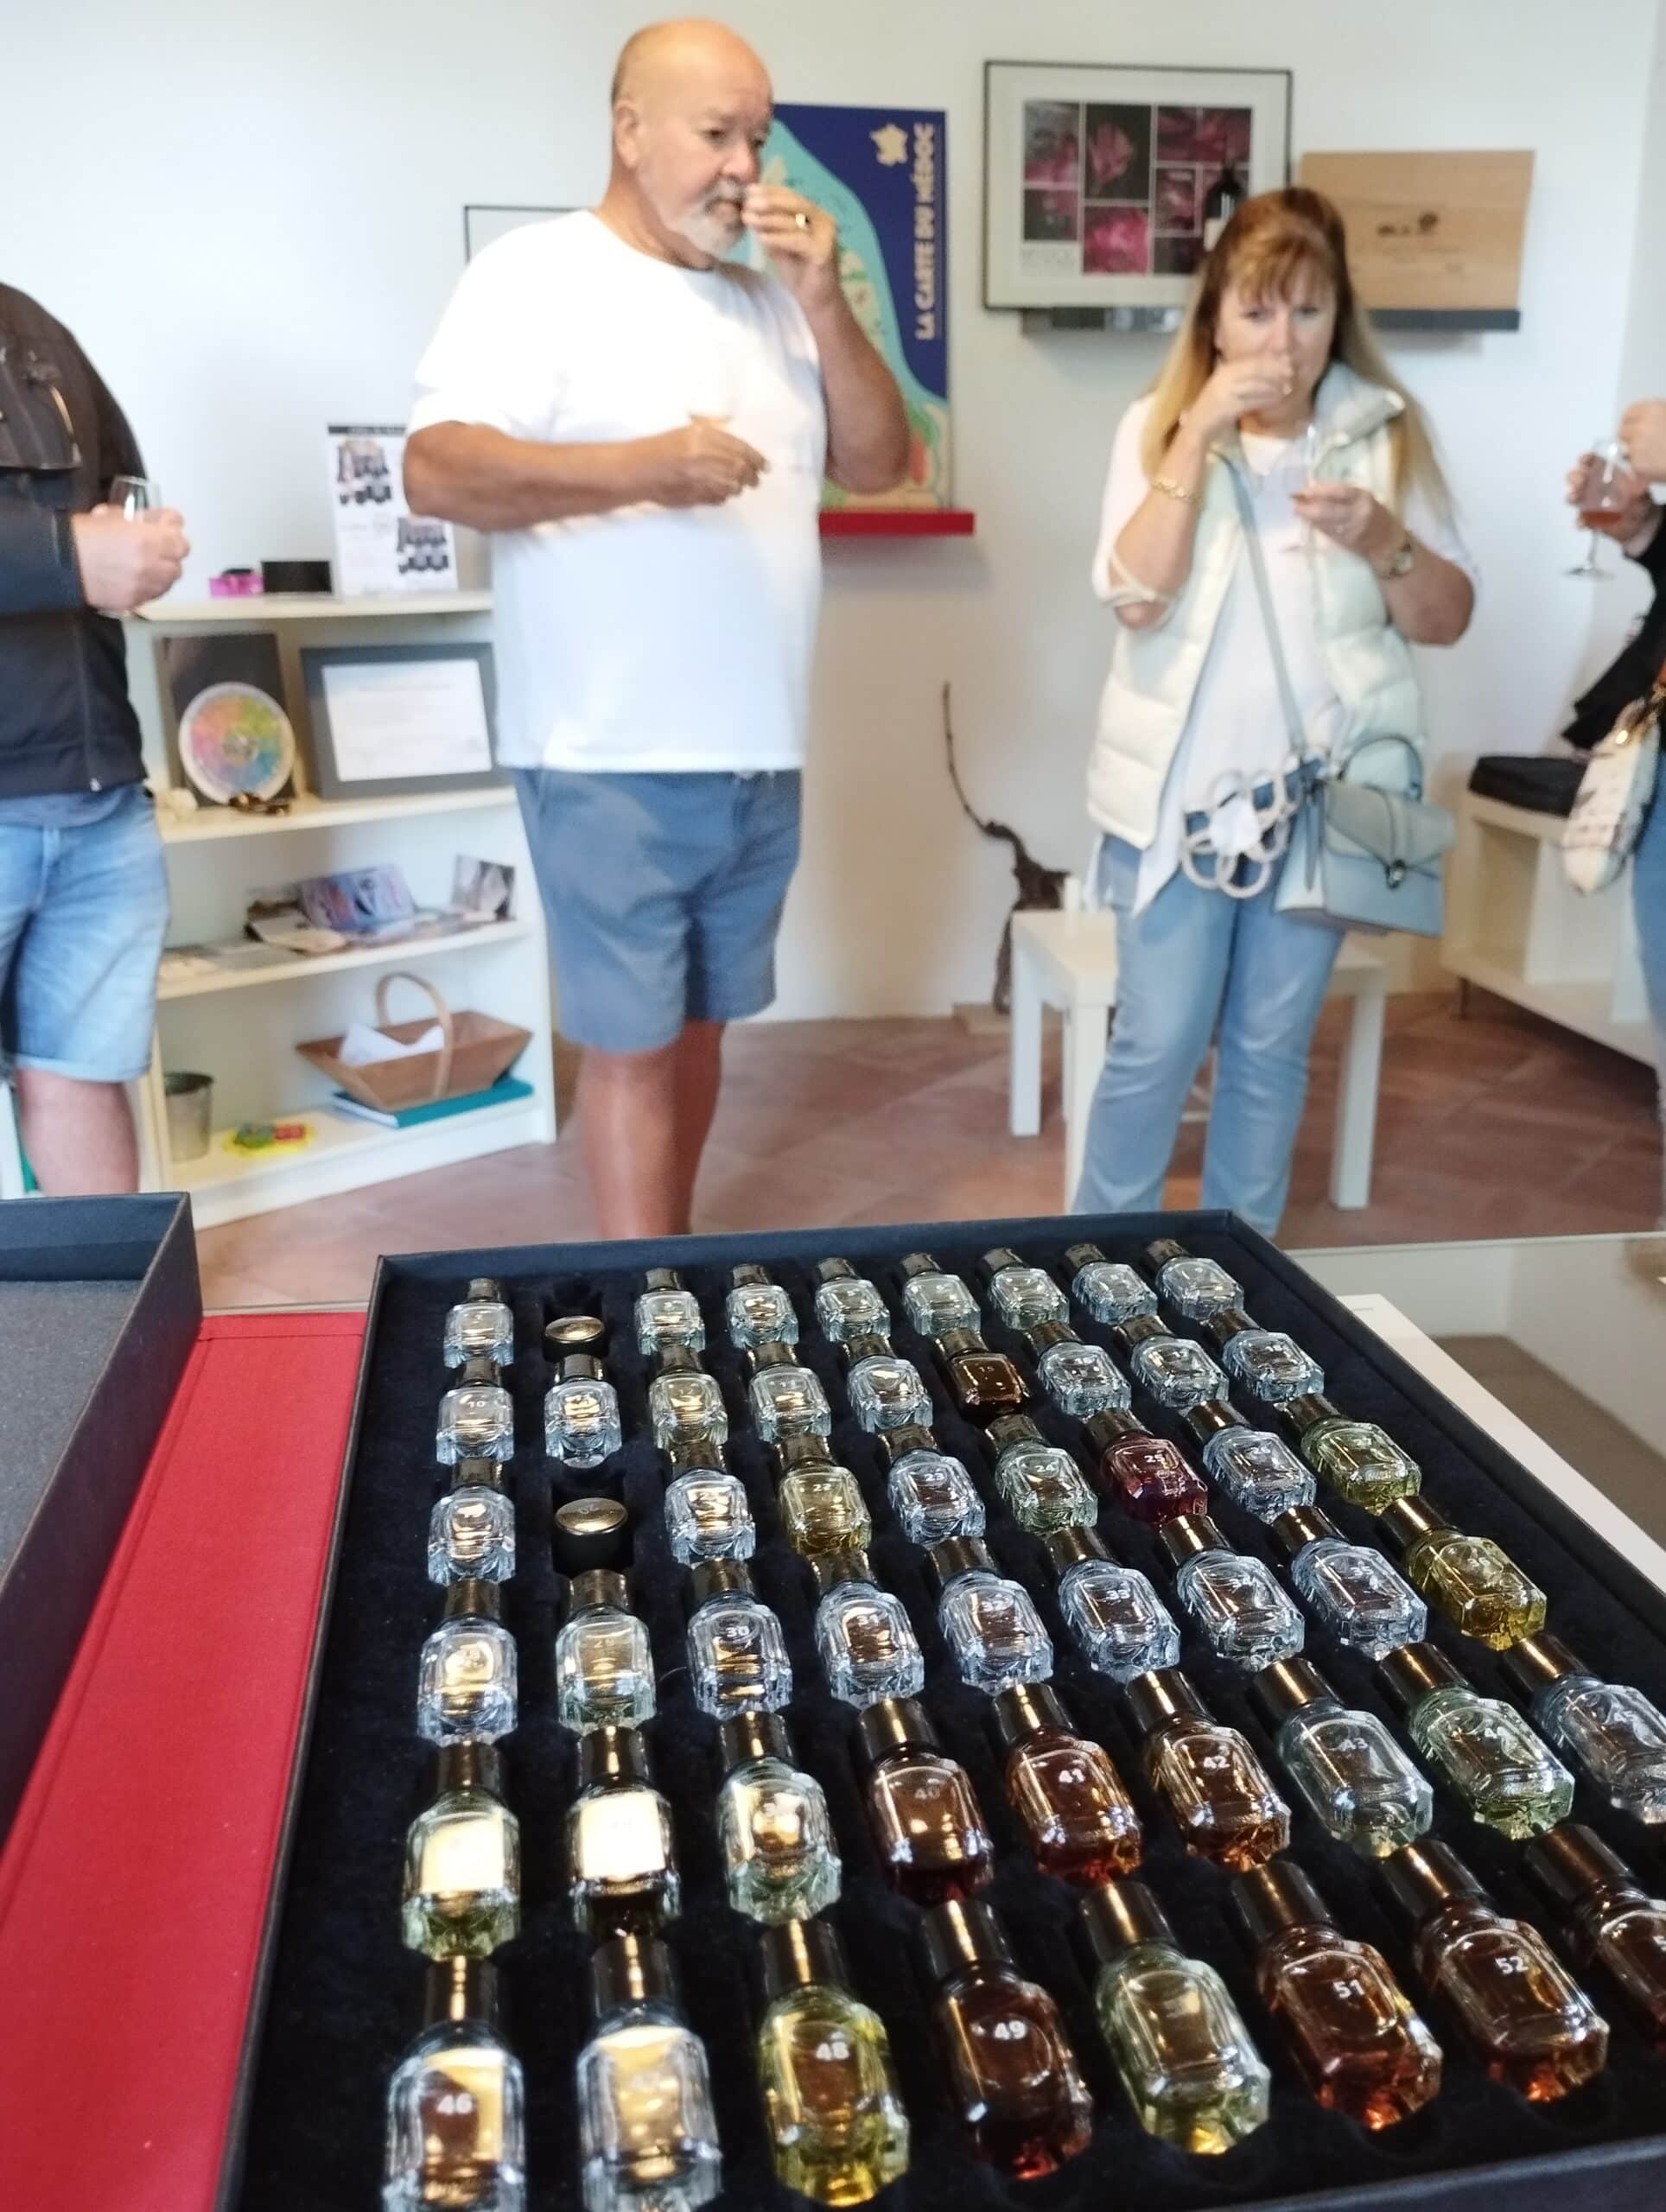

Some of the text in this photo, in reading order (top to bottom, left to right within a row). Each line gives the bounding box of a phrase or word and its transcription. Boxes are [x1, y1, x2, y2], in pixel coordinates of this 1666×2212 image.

[914, 206, 934, 238] DU
[914, 241, 934, 311] CARTE
[914, 313, 934, 340] LA
[1144, 1453, 1166, 1463] 25
[1035, 1463, 1057, 1472] 24
[924, 1471, 944, 1481] 23
[813, 1483, 832, 1491] 22
[1351, 1565, 1372, 1576] 35
[1106, 1589, 1130, 1601] 33
[857, 1614, 880, 1625] 31
[726, 1625, 750, 1637] 30
[1338, 1737, 1368, 1751] 43
[1203, 1755, 1231, 1769] 42
[1059, 1769, 1086, 1783] 41
[1494, 1955, 1529, 1974] 52
[1332, 1979, 1365, 1999] 51
[995, 2020, 1027, 2040] 49
[816, 2041, 849, 2061] 48
[437, 2093, 473, 2114] 46
